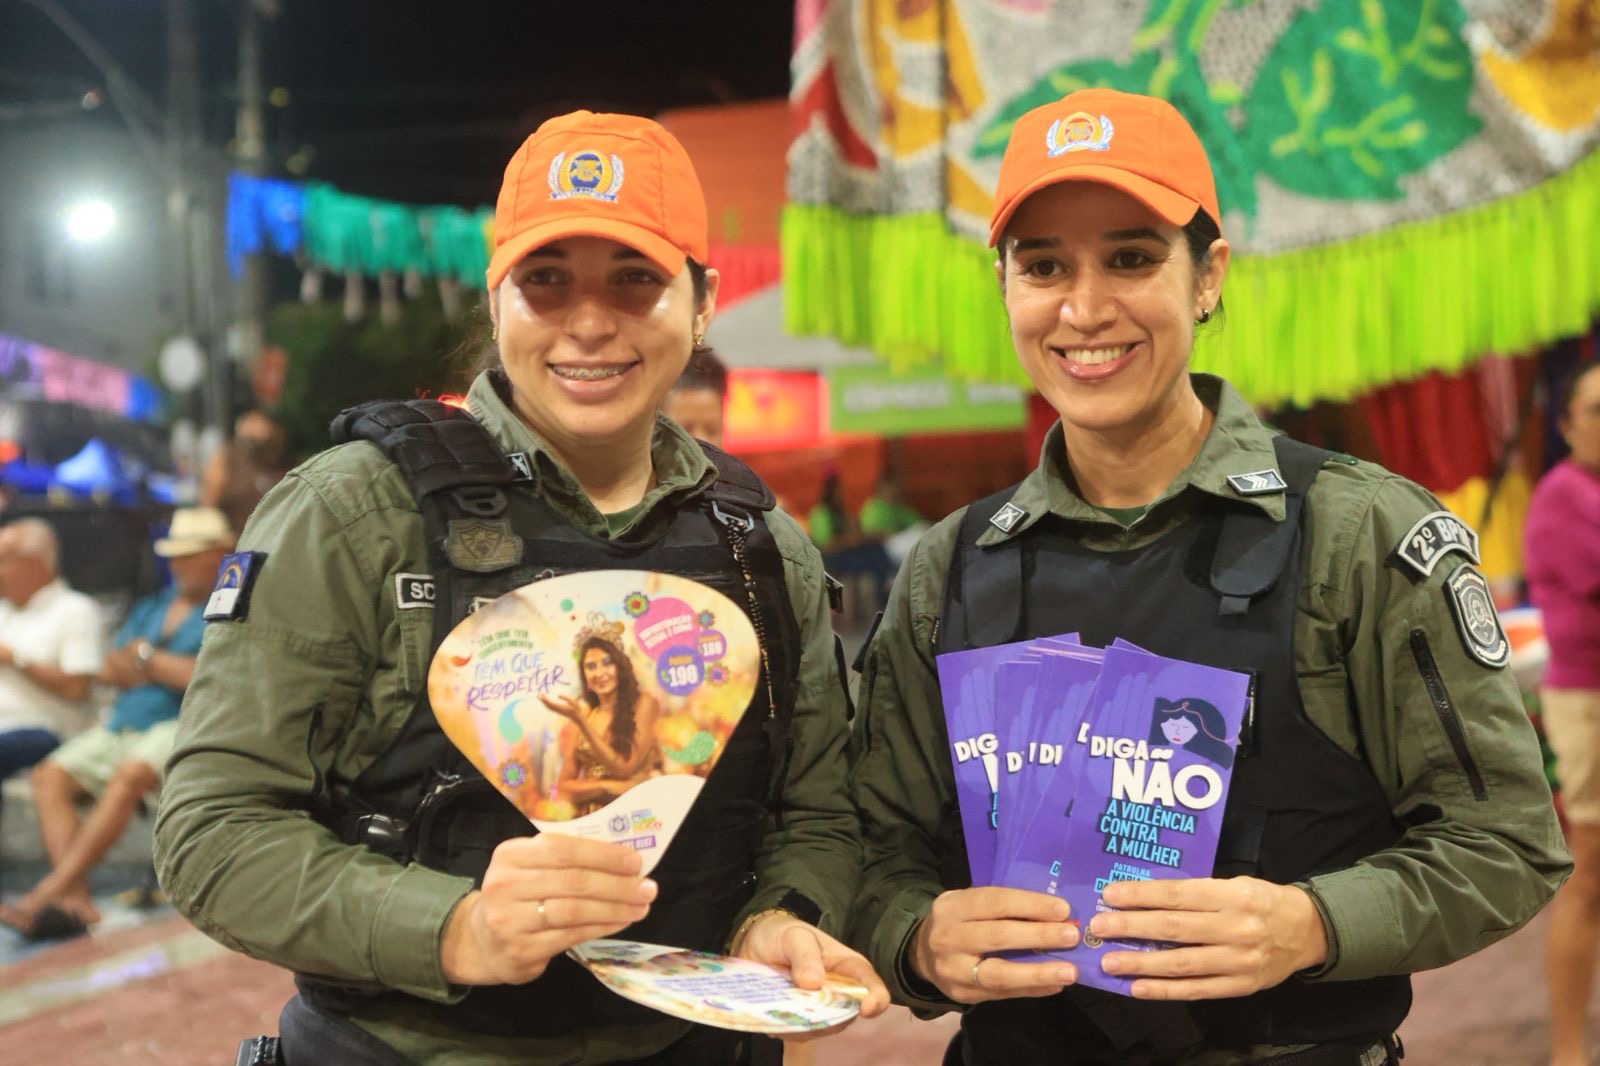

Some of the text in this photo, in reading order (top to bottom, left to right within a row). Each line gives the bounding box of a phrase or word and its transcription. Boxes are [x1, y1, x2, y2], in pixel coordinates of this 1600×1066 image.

[474, 652, 546, 682] TEM QUE
[668, 664, 699, 687] 190
[467, 665, 571, 711] RESPEITAR
[1091, 736, 1149, 760] DIGA
[1111, 748, 1223, 809] NÃO
[1100, 815, 1158, 843] CONTRA
[1106, 799, 1195, 833] A VIOLÊNCIA
[1106, 836, 1180, 867] A MULHER
[1114, 862, 1150, 877] PATRULHA
